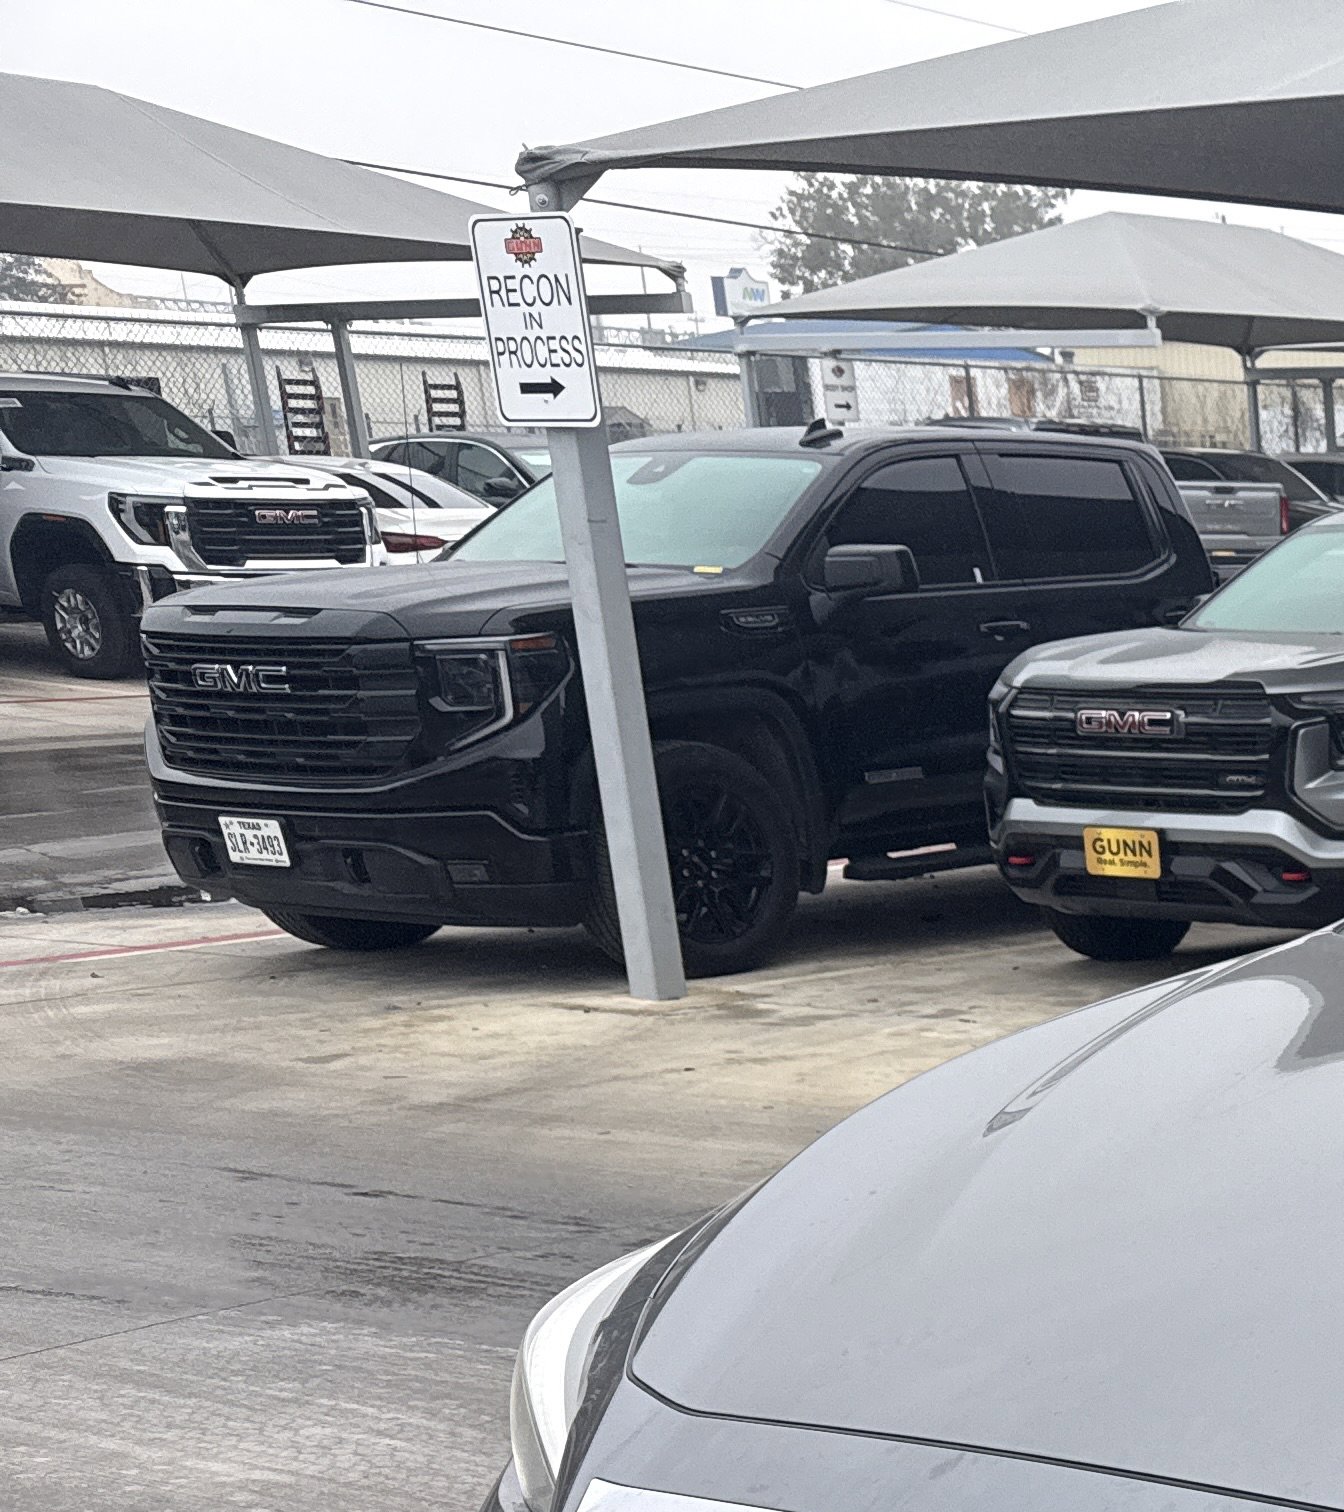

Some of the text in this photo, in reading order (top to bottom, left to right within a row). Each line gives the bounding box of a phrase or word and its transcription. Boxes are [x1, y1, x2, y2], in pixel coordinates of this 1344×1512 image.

[487, 273, 573, 308] RECON
[522, 311, 544, 331] IN
[494, 335, 585, 369] PROCESS
[255, 510, 319, 524] GMC
[191, 663, 291, 693] GMC
[1077, 709, 1171, 734] GMC
[236, 820, 262, 831] TEXAS
[1091, 837, 1153, 859] GUNN
